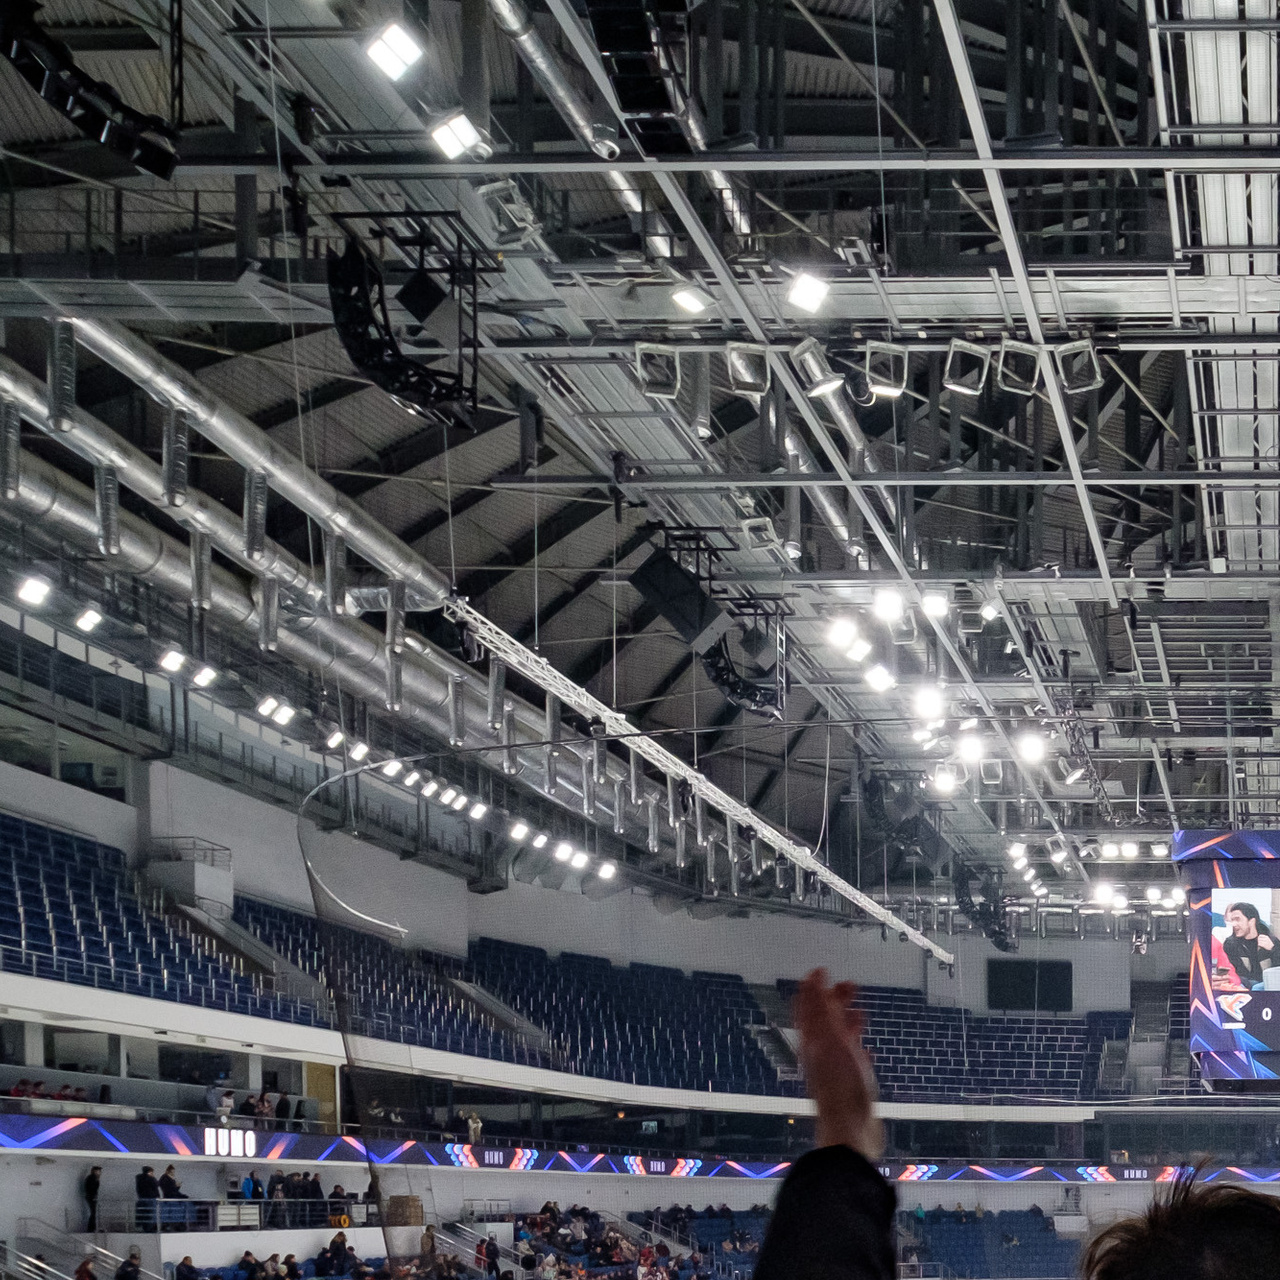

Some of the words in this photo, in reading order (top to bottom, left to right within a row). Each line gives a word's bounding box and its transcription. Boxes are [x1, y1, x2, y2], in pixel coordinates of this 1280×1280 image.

[1262, 1008, 1272, 1021] 0
[204, 1127, 256, 1157] HUMO
[484, 1150, 504, 1165] HUMO
[1124, 1169, 1148, 1179] HUMO
